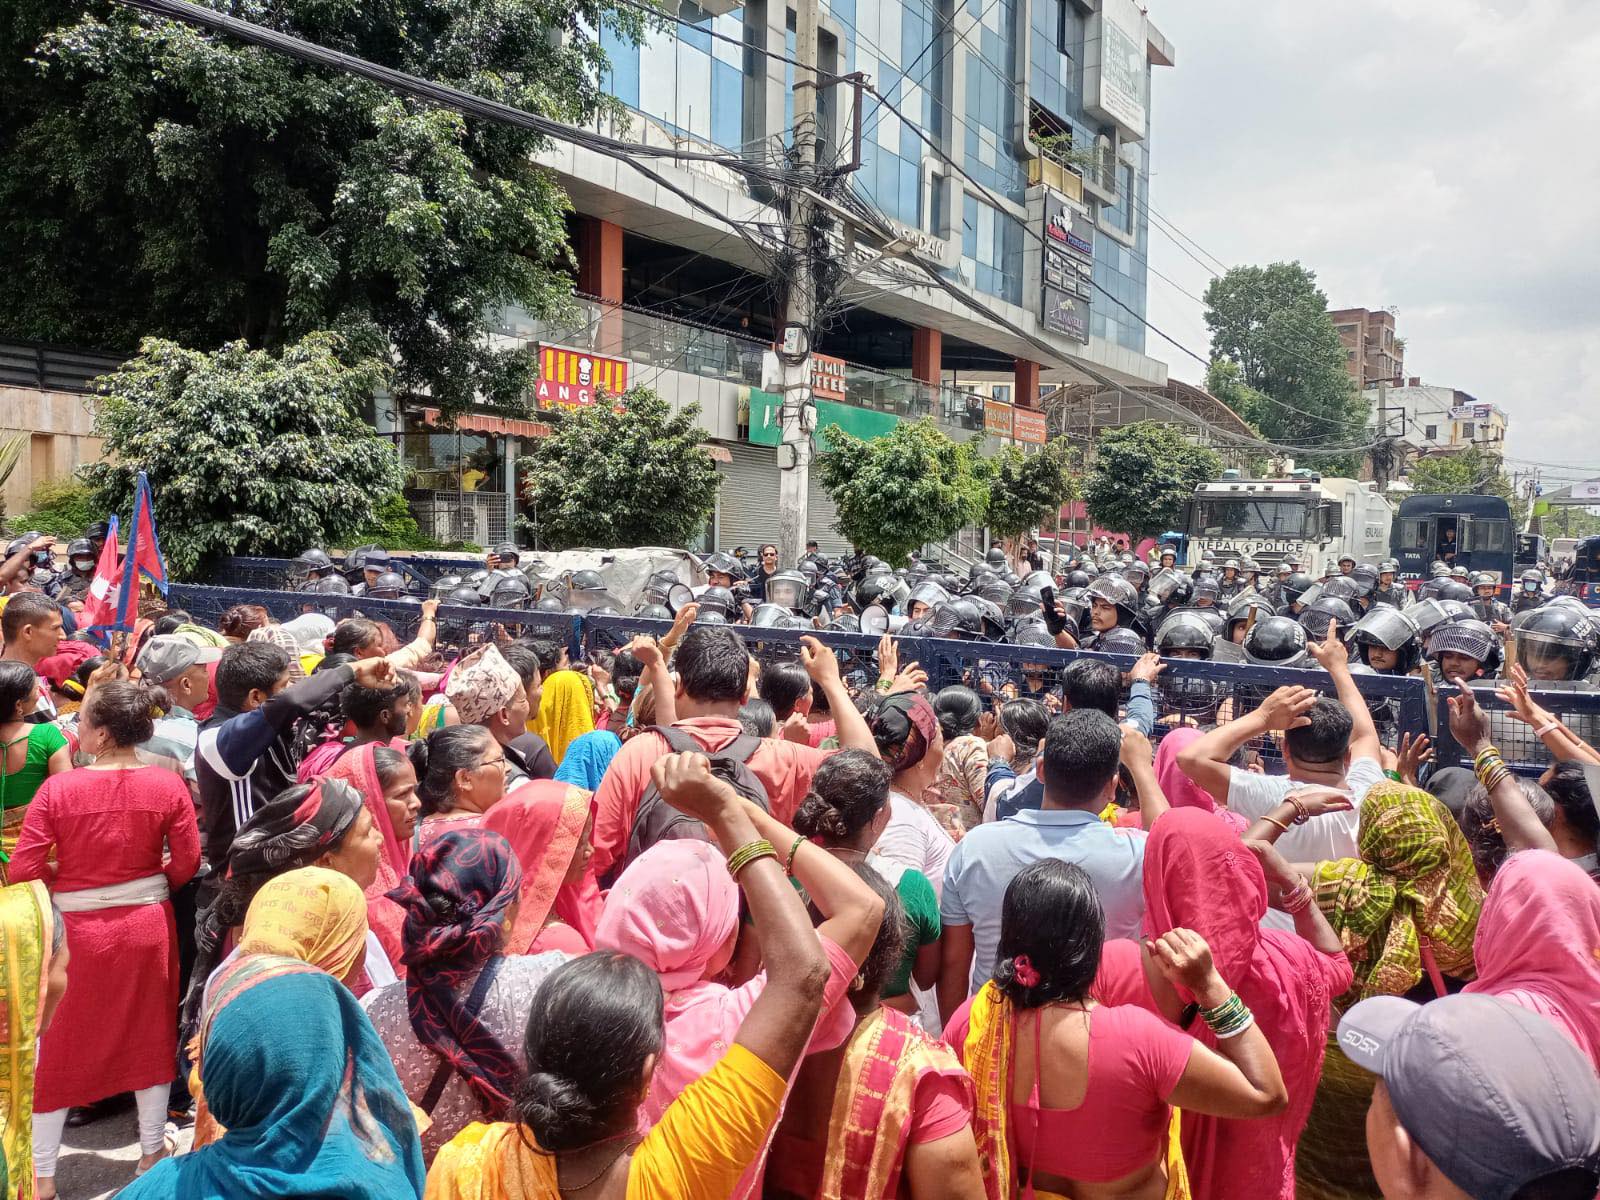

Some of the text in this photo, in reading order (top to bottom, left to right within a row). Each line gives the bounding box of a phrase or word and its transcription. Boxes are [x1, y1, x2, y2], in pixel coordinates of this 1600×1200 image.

[811, 358, 846, 377] EDMUD
[538, 380, 589, 404] ANG
[1197, 541, 1304, 552] NEPAL POLICE
[1342, 1029, 1380, 1057] SDSR
